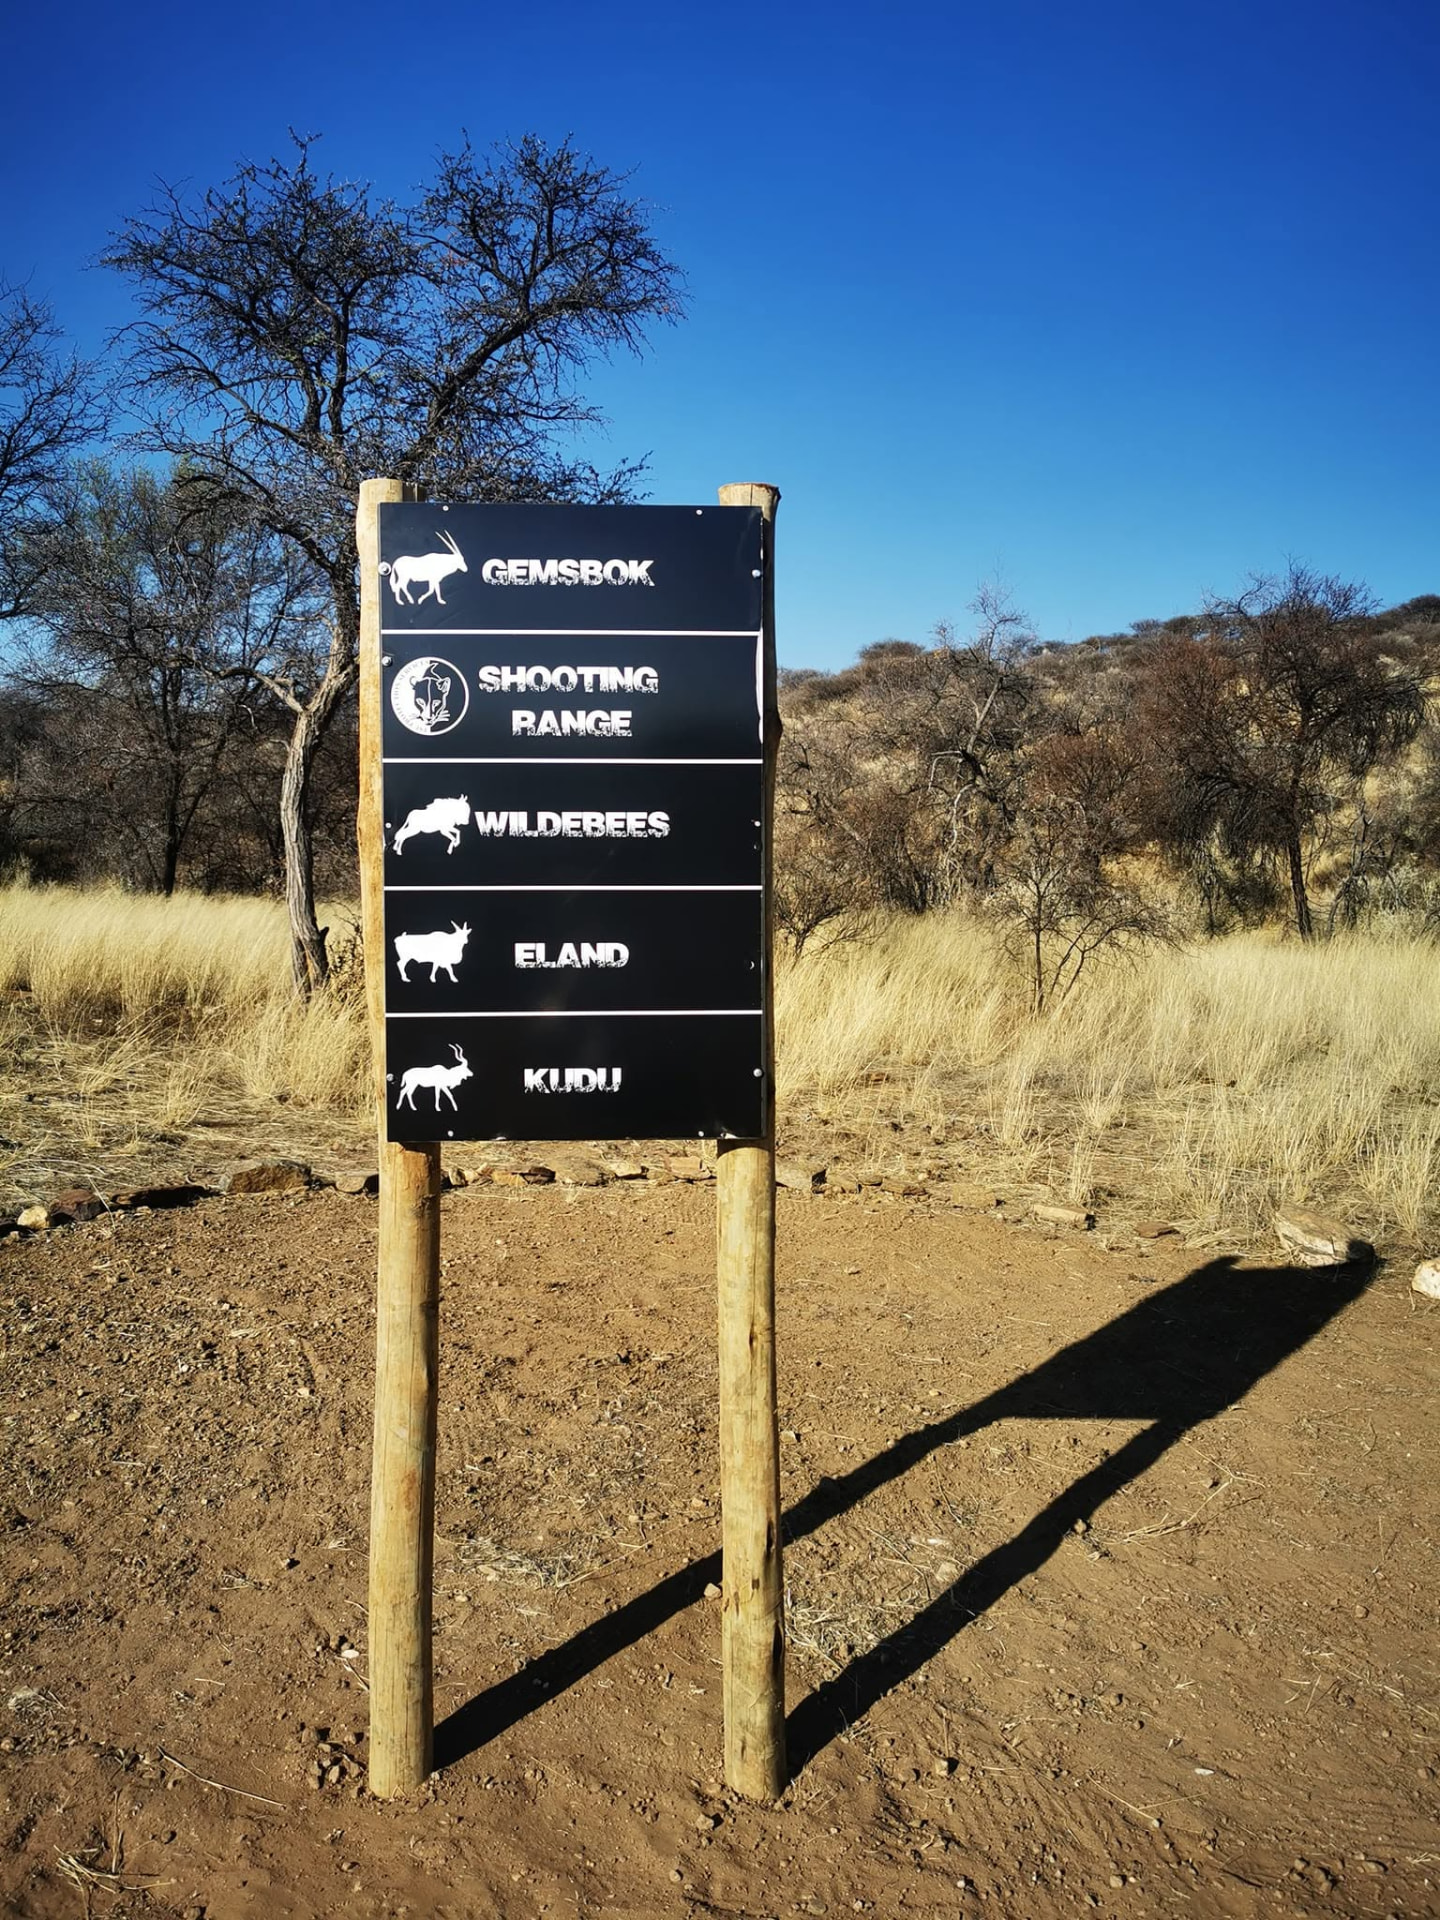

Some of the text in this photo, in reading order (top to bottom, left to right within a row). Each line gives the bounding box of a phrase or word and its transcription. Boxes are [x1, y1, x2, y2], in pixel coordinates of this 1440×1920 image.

[482, 559, 656, 587] GEMSBOK
[479, 666, 659, 694] SHOOTING
[511, 710, 633, 737] RANGE
[475, 811, 671, 838] WILDEBEES
[514, 942, 630, 969] ELAND
[524, 1067, 622, 1094] KUDU
